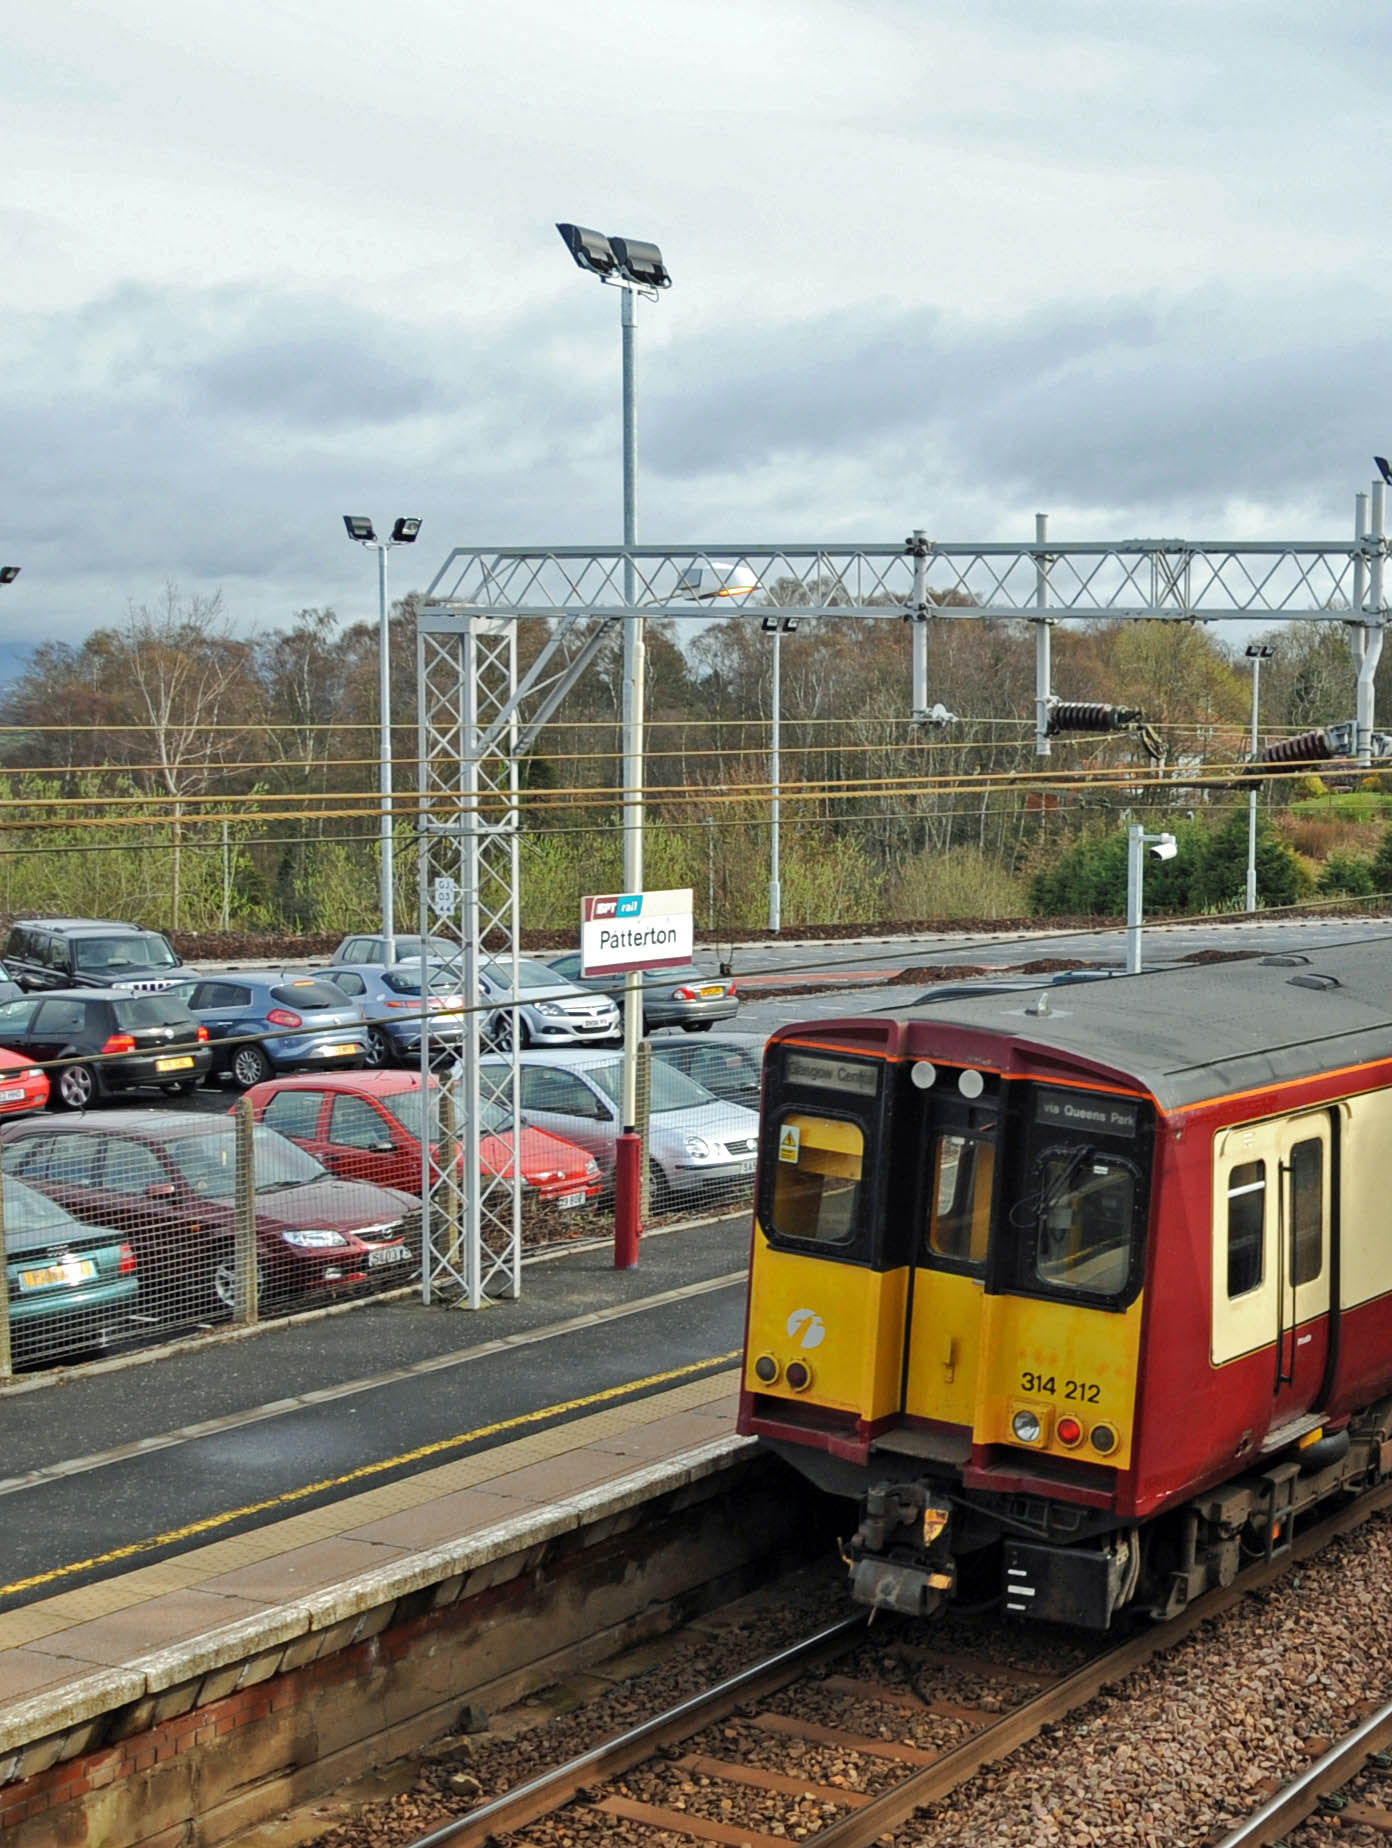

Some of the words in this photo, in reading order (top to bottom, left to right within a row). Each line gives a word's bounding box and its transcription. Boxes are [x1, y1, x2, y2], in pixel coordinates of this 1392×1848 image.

[621, 901, 638, 912] rail
[600, 927, 677, 950] Patterton
[1043, 1102, 1060, 1114] via
[1063, 1104, 1107, 1122] Queens
[1110, 1112, 1135, 1126] Park
[1021, 1372, 1056, 1396] 314
[1064, 1380, 1101, 1404] 212
